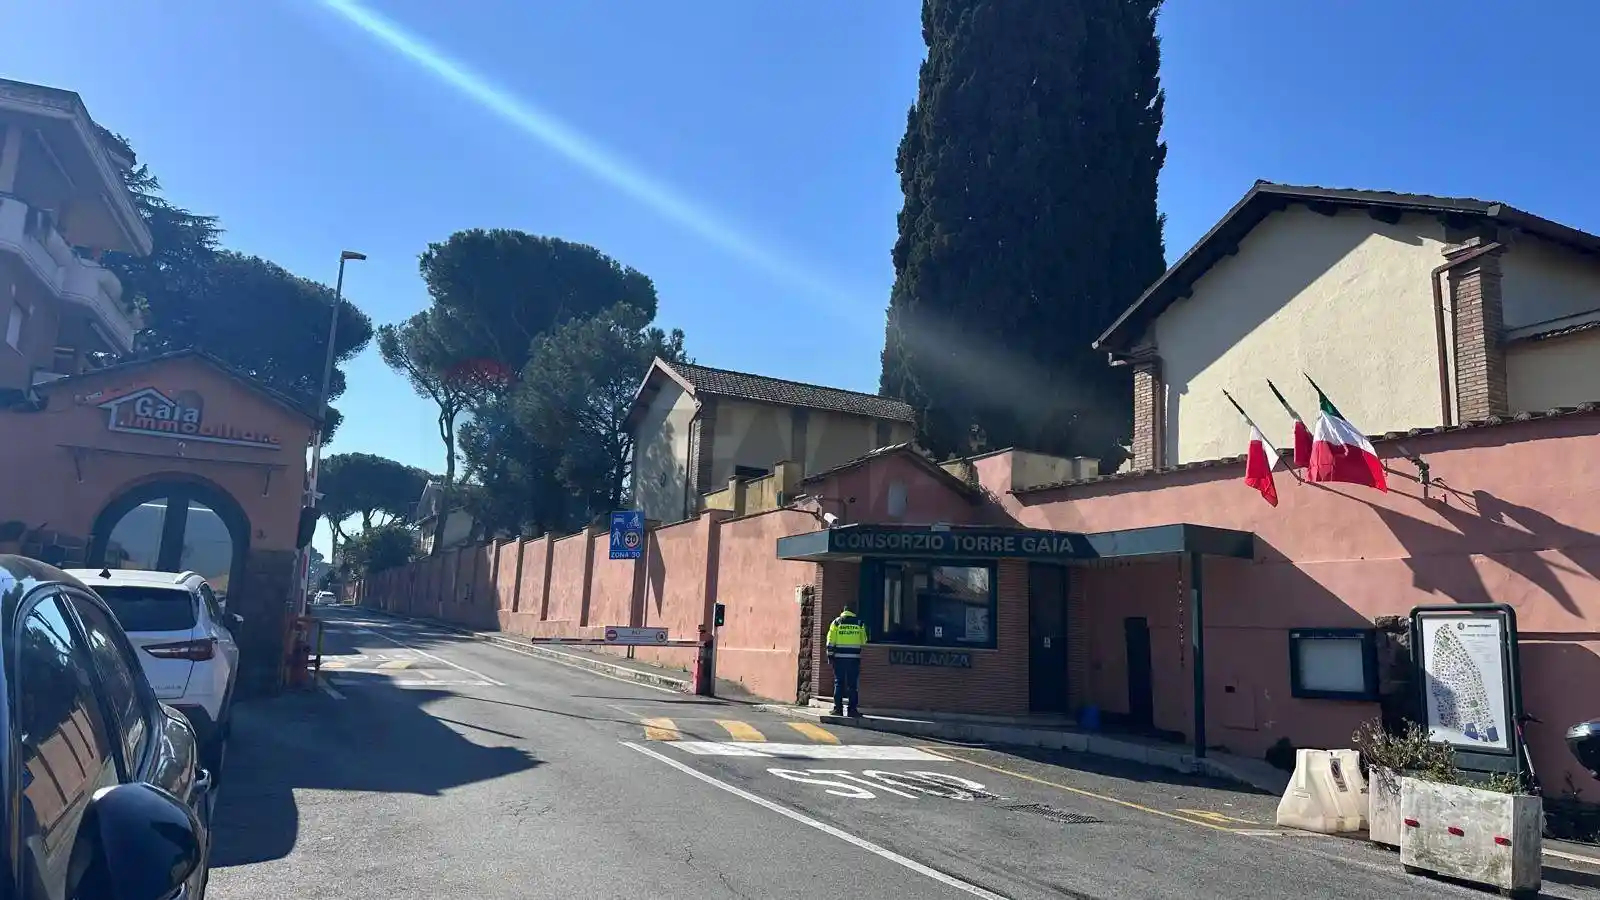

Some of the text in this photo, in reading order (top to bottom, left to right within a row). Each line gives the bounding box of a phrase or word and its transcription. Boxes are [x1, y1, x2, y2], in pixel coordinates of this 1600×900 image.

[134, 396, 199, 423] Gaia
[625, 533, 638, 545] 30
[834, 531, 1074, 554] CONSORZIO TORRE GAIA
[610, 551, 629, 559] ZONA
[890, 651, 971, 668] VIGILANZA
